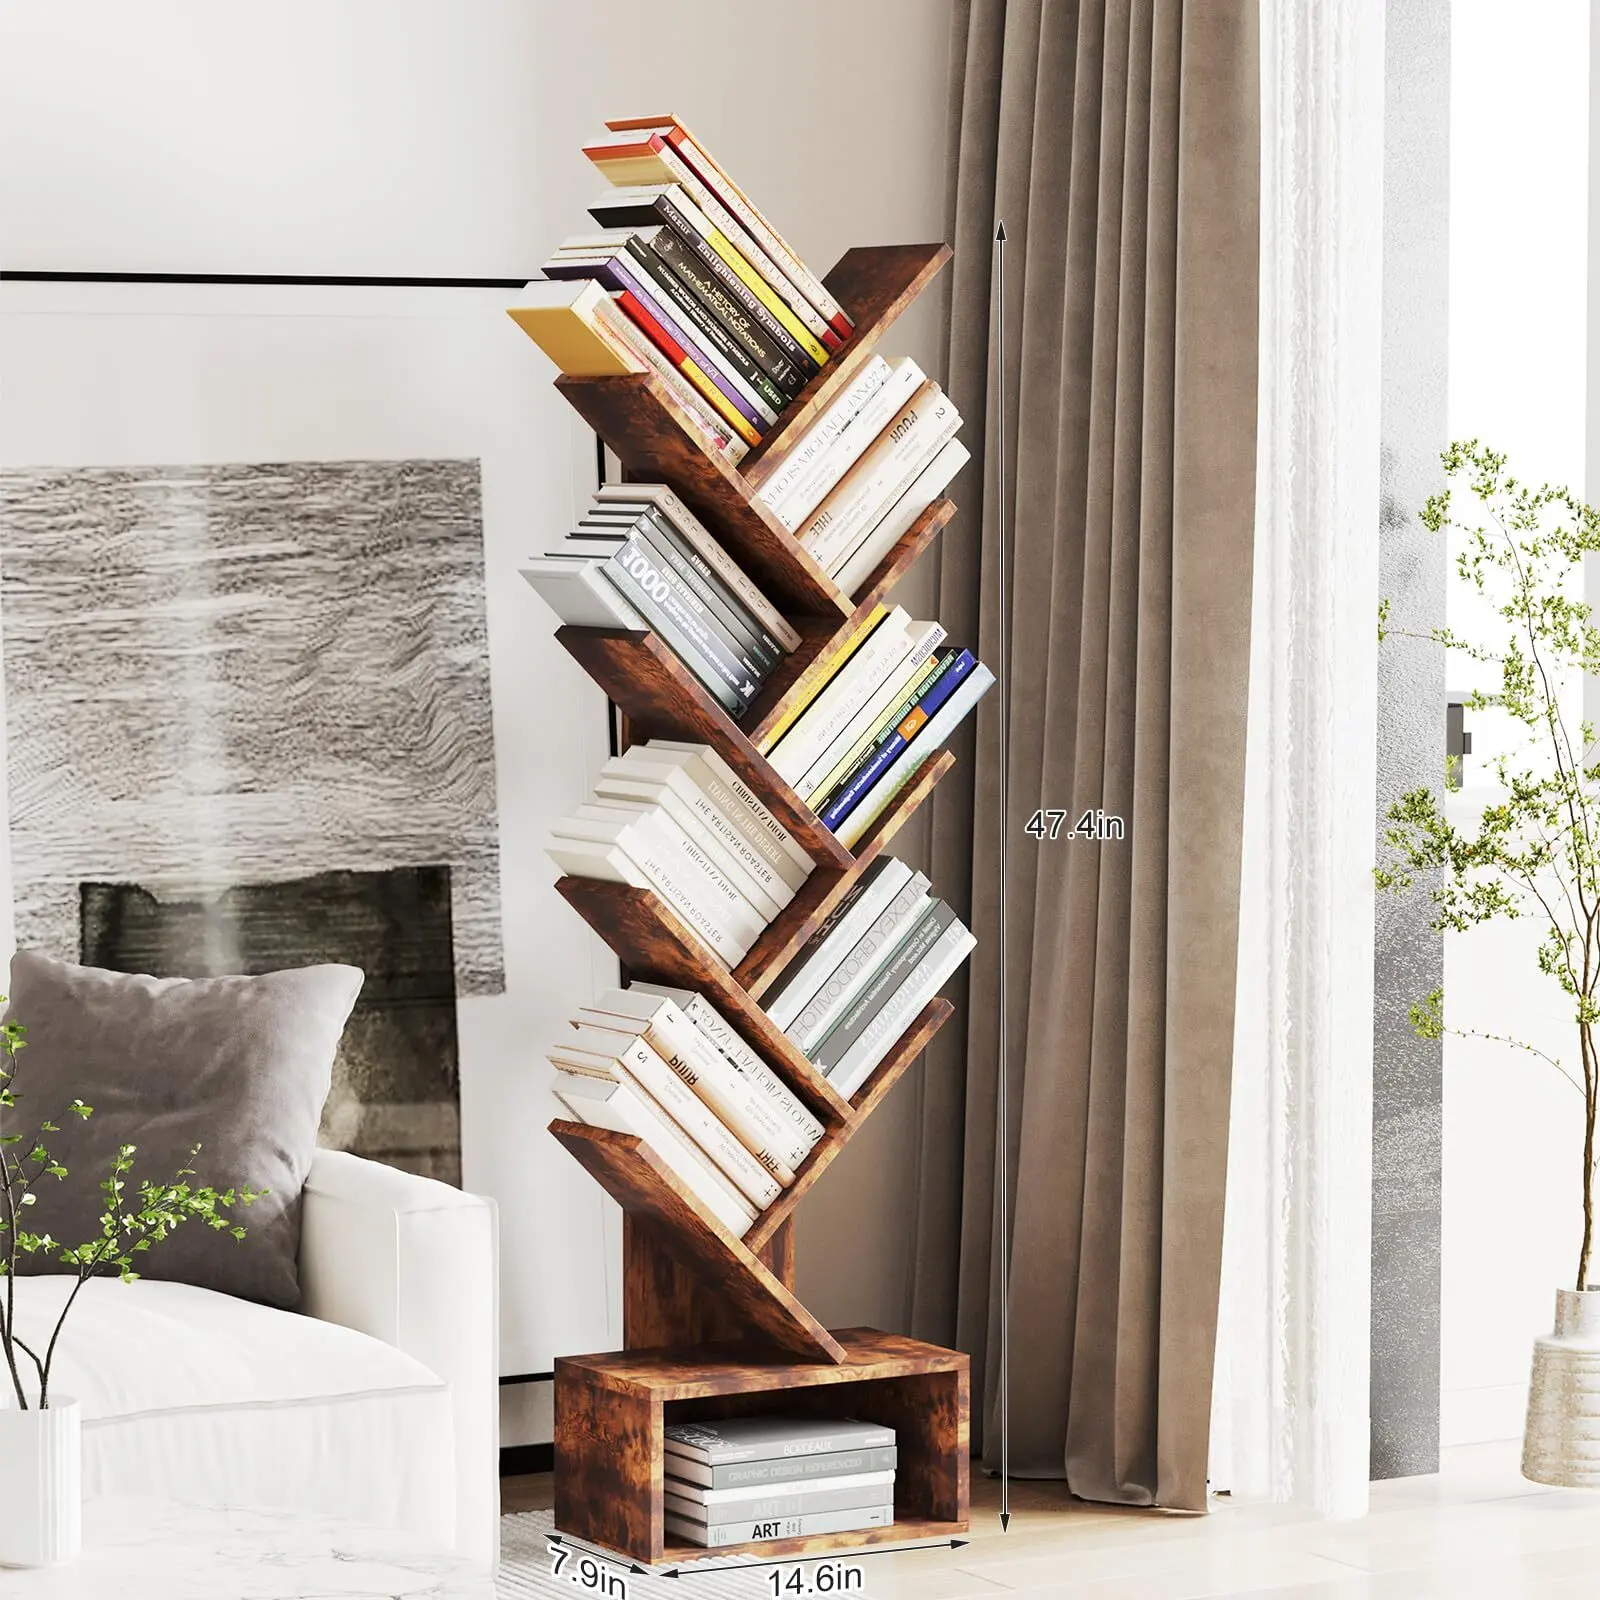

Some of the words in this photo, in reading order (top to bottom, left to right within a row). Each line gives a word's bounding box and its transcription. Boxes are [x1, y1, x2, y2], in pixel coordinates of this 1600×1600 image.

[697, 186, 746, 240] BEFORE
[749, 245, 807, 310] WRITING
[662, 203, 692, 237] Mazur
[695, 239, 759, 310] Enlightening
[753, 305, 798, 354] Symbols
[702, 278, 712, 288] A
[709, 286, 740, 319] HISTORY
[737, 315, 751, 329] OF
[634, 288, 645, 299] An
[672, 329, 686, 344] The
[681, 340, 701, 362] Story
[697, 357, 709, 370] of
[655, 263, 680, 290] NUMBER
[675, 285, 698, 309] WORDS
[693, 305, 708, 321] AND
[704, 317, 728, 343] NUMBER
[724, 339, 750, 367] SYMBOLS
[676, 259, 731, 319] MATHEMATICAL
[726, 314, 767, 359] NOTATIONS
[761, 383, 783, 406] USED
[784, 462, 802, 480] IS
[796, 410, 847, 466] MICHAEL
[887, 408, 920, 444] PUUR
[807, 509, 834, 539] THEE
[728, 1467, 768, 1482] GRAPHIC
[751, 1521, 781, 1540] ART
